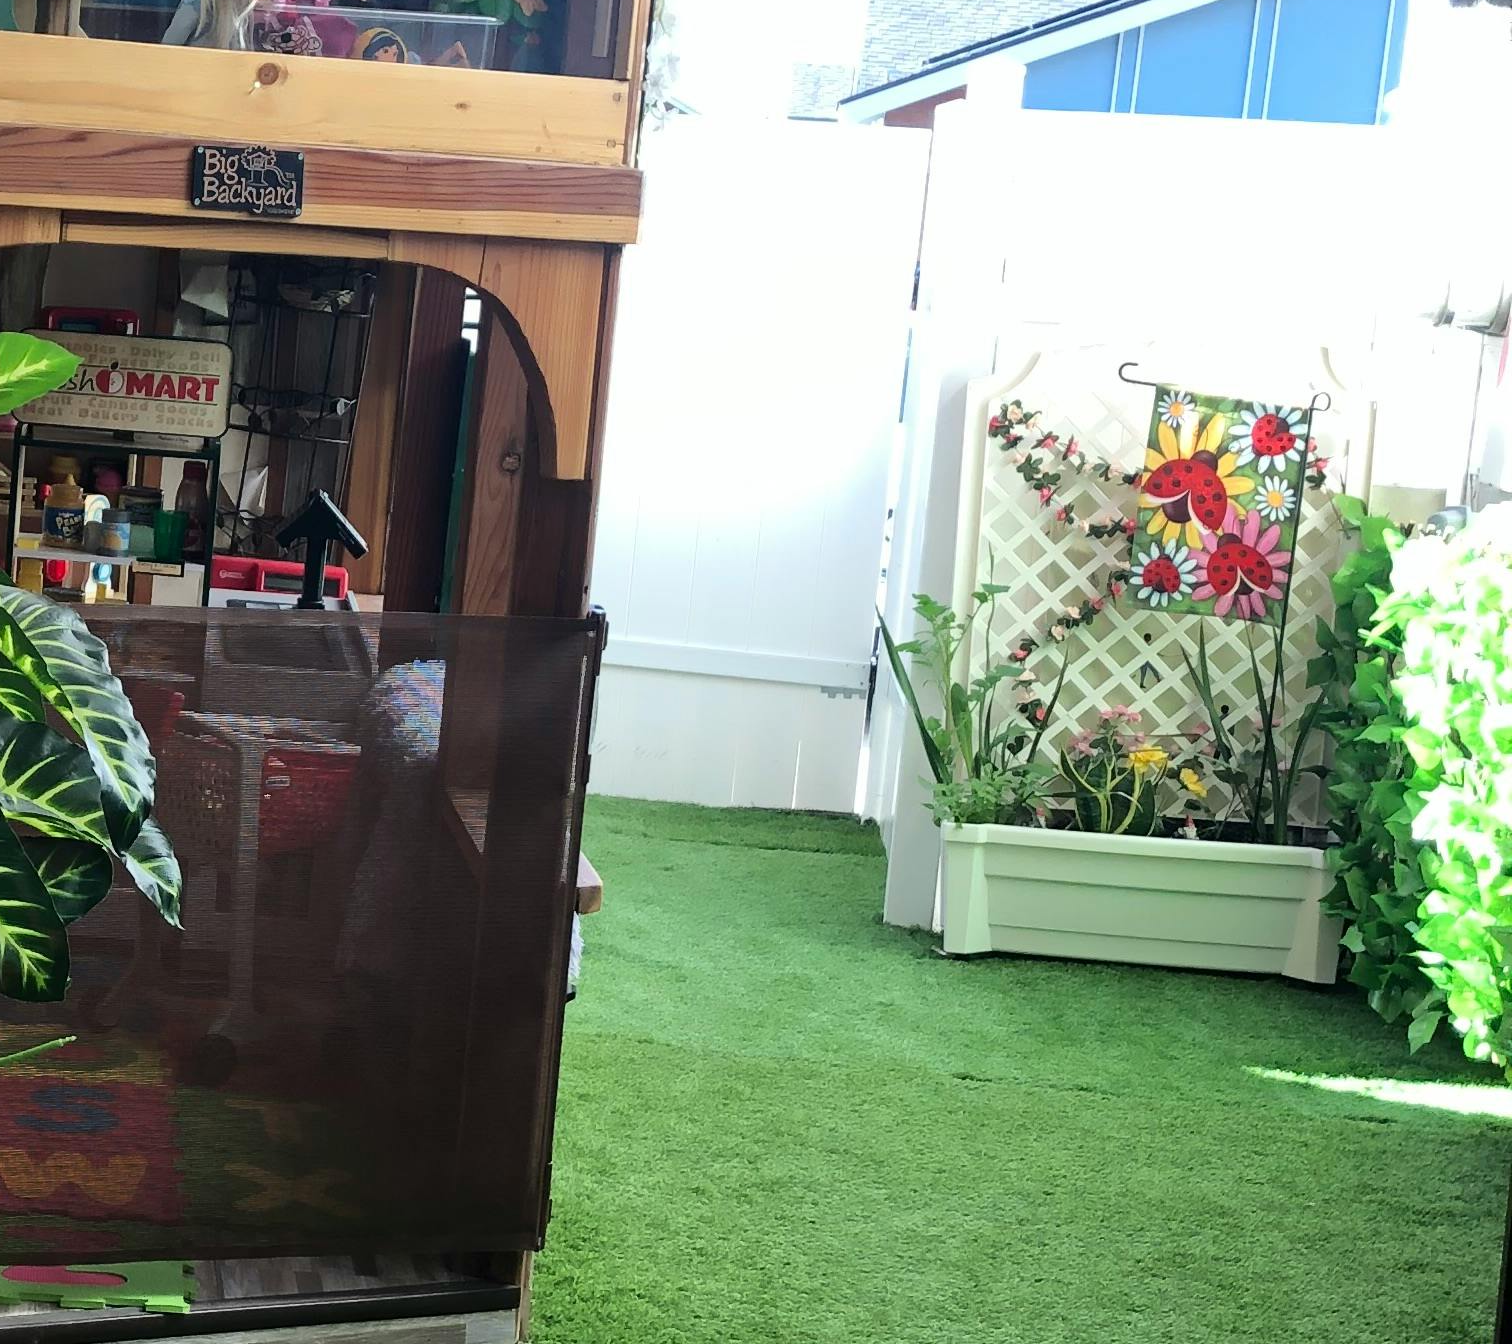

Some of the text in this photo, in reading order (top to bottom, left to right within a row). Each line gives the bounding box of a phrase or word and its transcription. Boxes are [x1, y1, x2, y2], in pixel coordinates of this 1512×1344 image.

[203, 148, 239, 184] Big
[201, 177, 297, 213] Backyard
[125, 371, 219, 402] MART
